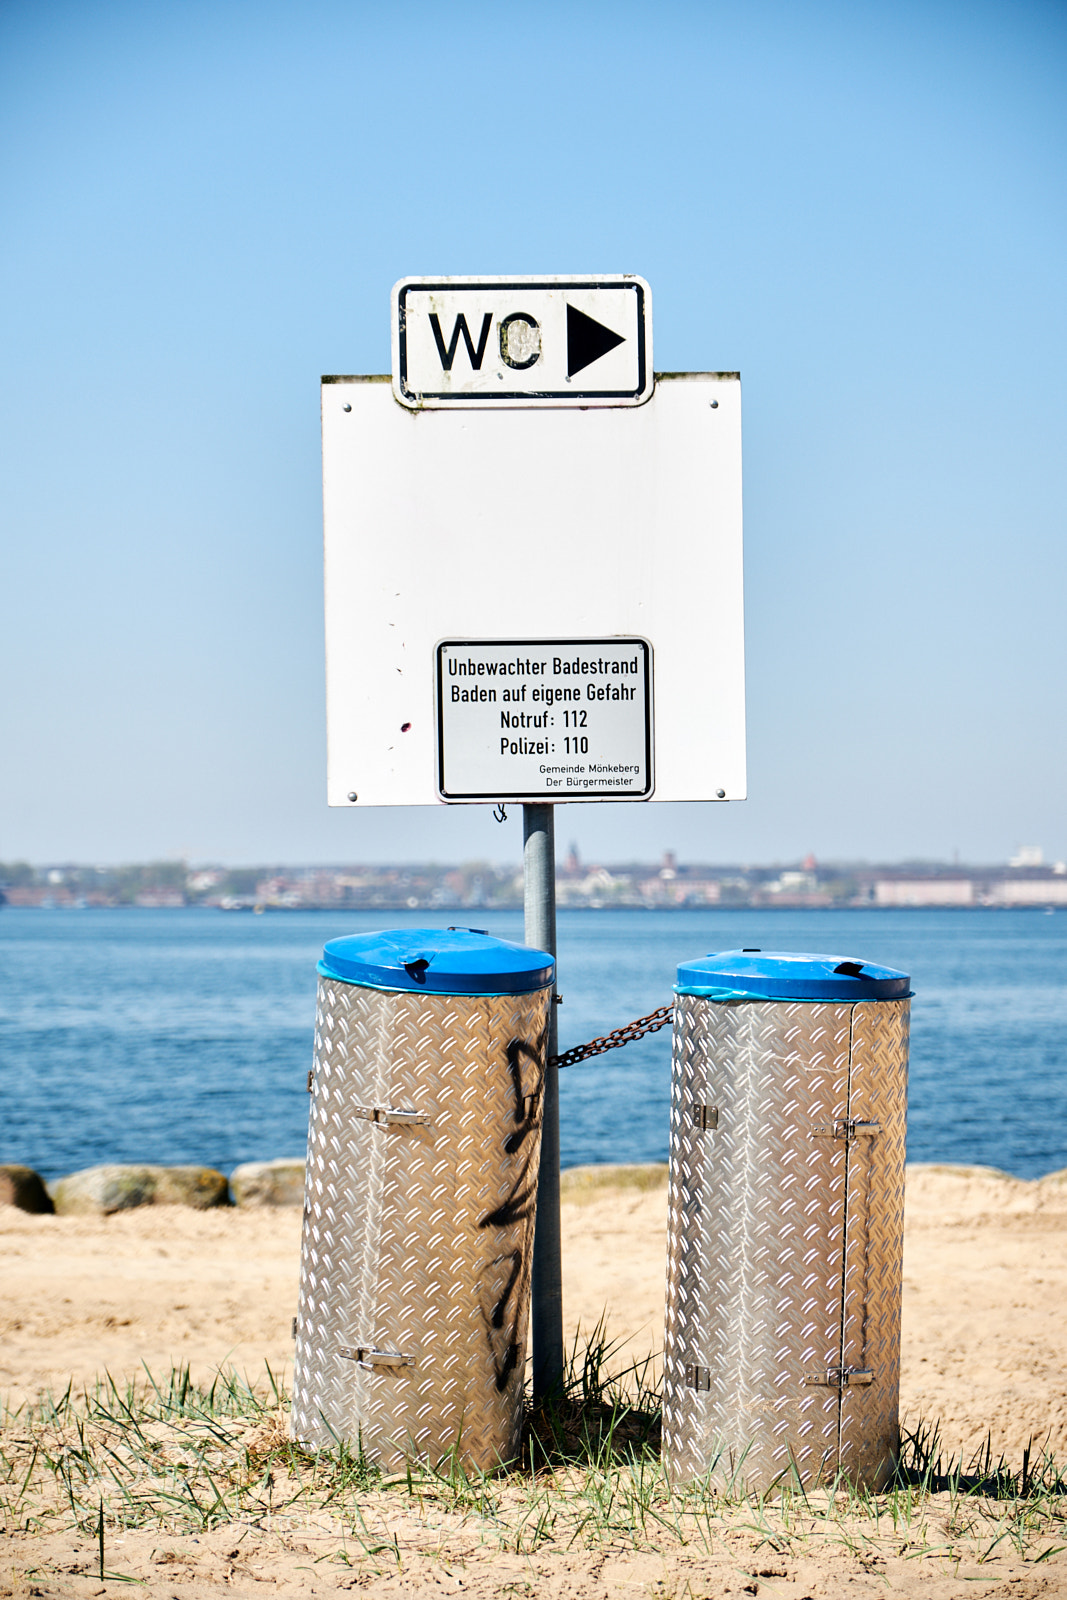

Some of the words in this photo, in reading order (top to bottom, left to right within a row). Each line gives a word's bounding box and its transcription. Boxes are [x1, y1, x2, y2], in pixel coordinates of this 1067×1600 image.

[428, 311, 541, 371] WC
[448, 658, 547, 676] Unbewachter
[552, 656, 638, 675] Badestrand
[451, 685, 497, 703] Baden
[502, 684, 527, 702] auf
[532, 684, 581, 706] eigene
[586, 683, 637, 701] Gefahr
[500, 710, 555, 729] Notruf:
[563, 710, 588, 728] 112
[500, 737, 556, 755] Polizei:
[564, 736, 589, 754] 110
[539, 764, 585, 774] Gemeinde
[588, 764, 640, 774] Mönkeberg
[546, 778, 563, 787] Der
[566, 777, 634, 788] Bürgermeister
